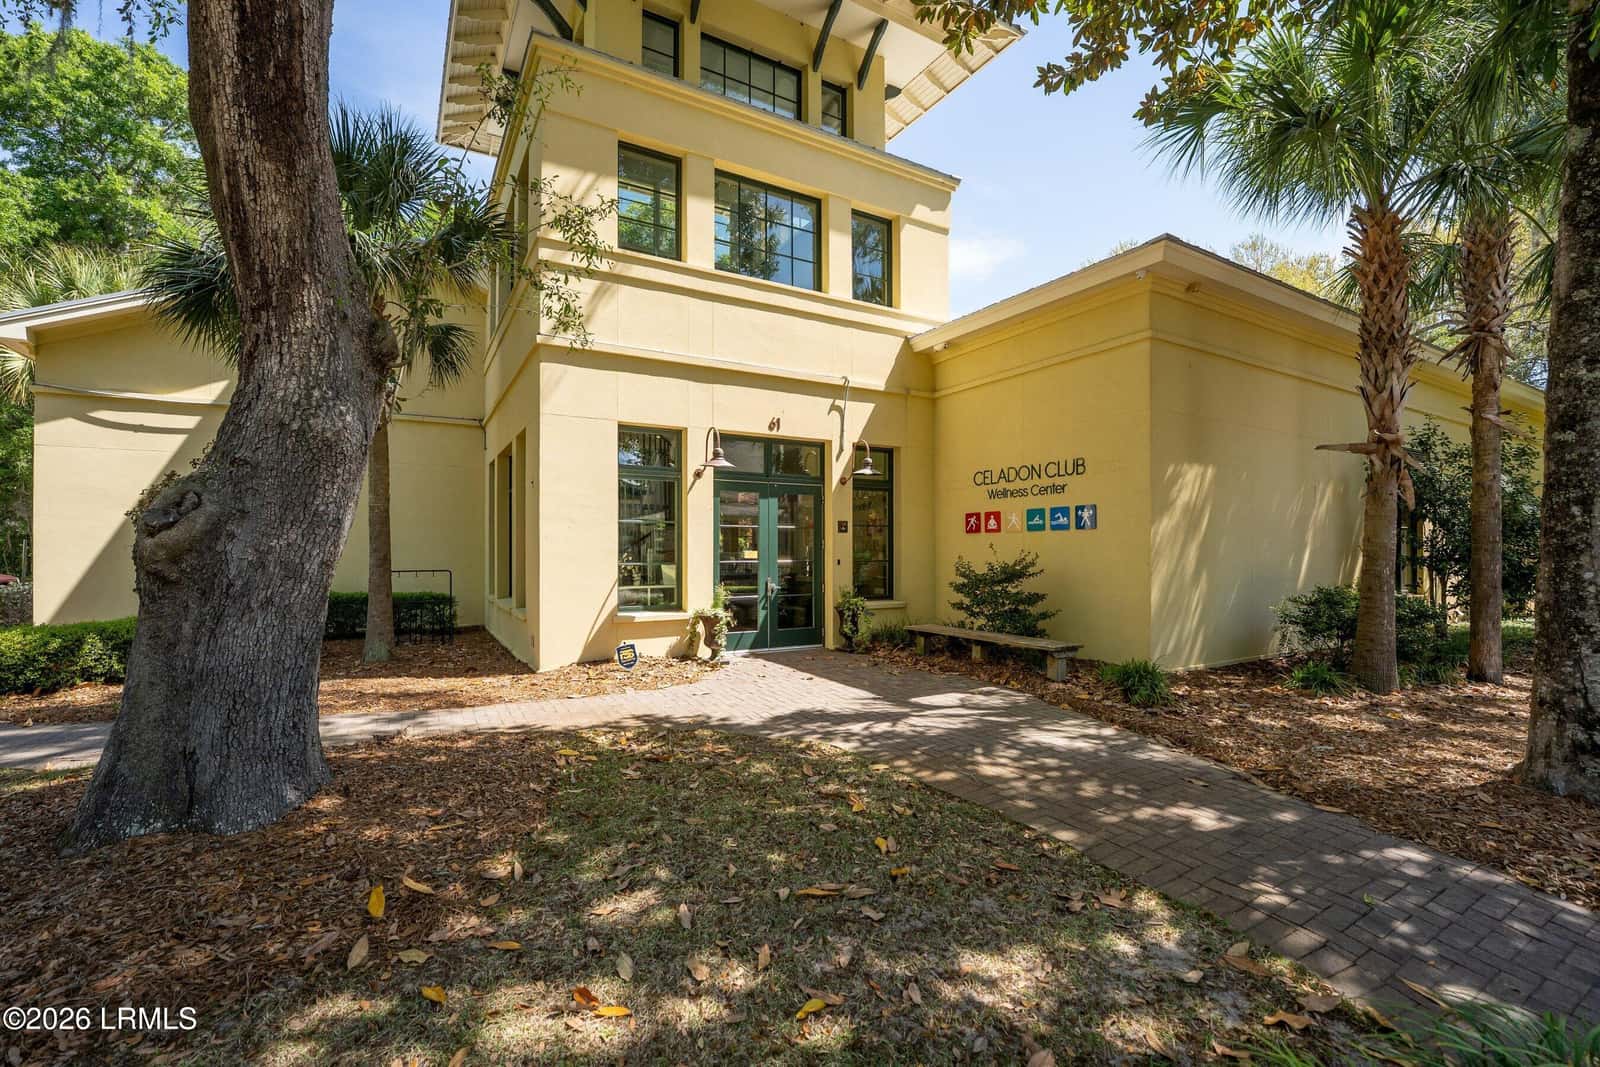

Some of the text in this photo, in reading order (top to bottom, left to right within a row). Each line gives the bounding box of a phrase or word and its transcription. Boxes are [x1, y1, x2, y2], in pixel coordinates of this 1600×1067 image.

[768, 416, 781, 432] 61
[973, 457, 1087, 487] CELADON CLUB
[987, 482, 1068, 500] Wellness Center
